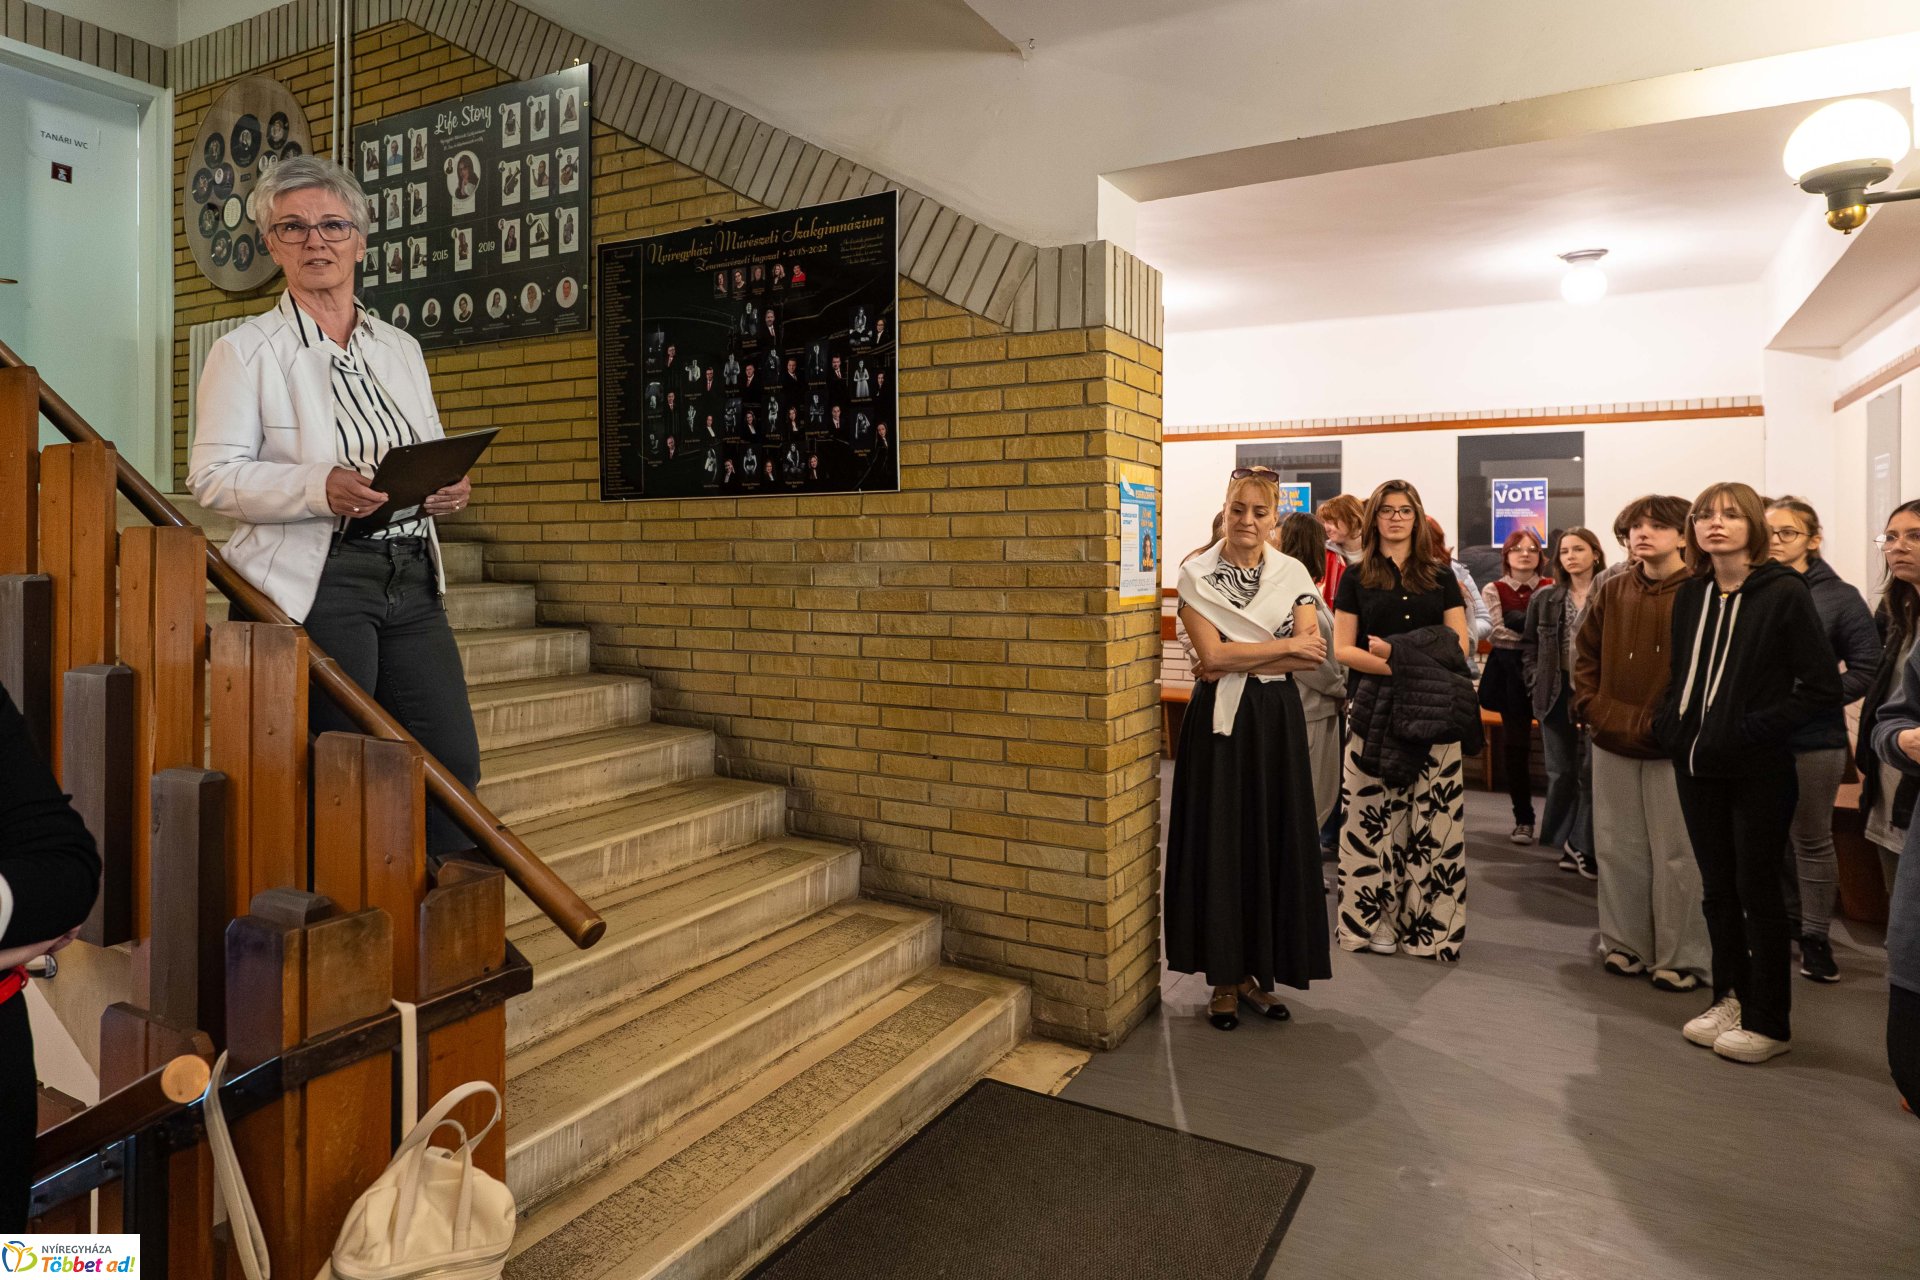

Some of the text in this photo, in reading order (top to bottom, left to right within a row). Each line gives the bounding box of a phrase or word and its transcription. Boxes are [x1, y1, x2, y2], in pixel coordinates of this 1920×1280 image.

[434, 105, 492, 135] Life Story
[40, 130, 88, 150] TANÁRI WC
[478, 240, 496, 253] 2019
[647, 238, 714, 265] Nyíregyházi
[782, 214, 885, 242] Szakgimnázium
[432, 249, 449, 262] 2015
[1494, 485, 1545, 504] VOTE
